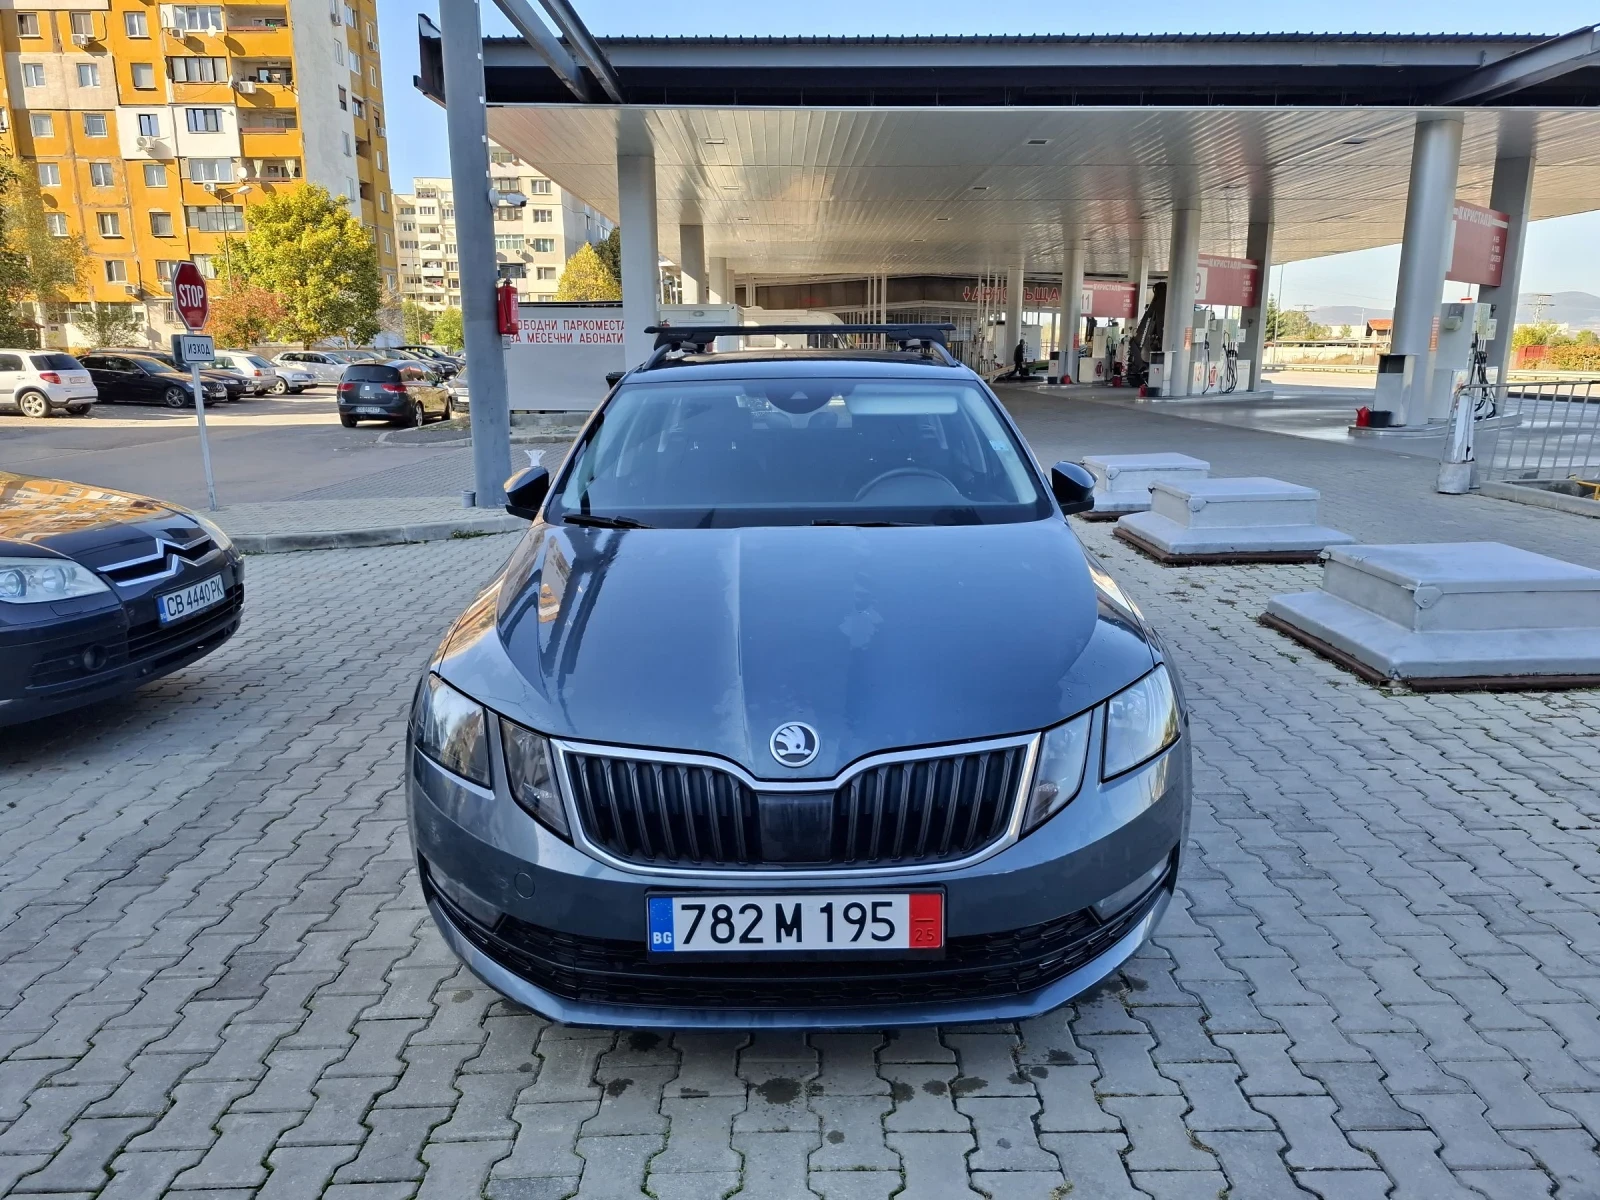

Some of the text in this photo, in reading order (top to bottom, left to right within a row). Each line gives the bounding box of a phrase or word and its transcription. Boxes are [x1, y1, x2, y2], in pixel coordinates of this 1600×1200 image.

[1195, 273, 1201, 294] 9
[179, 284, 204, 308] STOP
[971, 286, 1060, 303] АВТОЪЩА
[1081, 294, 1089, 310] 11
[517, 320, 557, 332] ОБОДНИ
[527, 333, 573, 343] МЕСЕЧНИ
[580, 333, 624, 343] АБОНАТИ
[187, 344, 211, 355] ИЗХОД
[186, 583, 211, 609] 4440
[680, 901, 896, 945] 782 M 195
[652, 931, 673, 945] BG
[914, 928, 934, 942] 25
